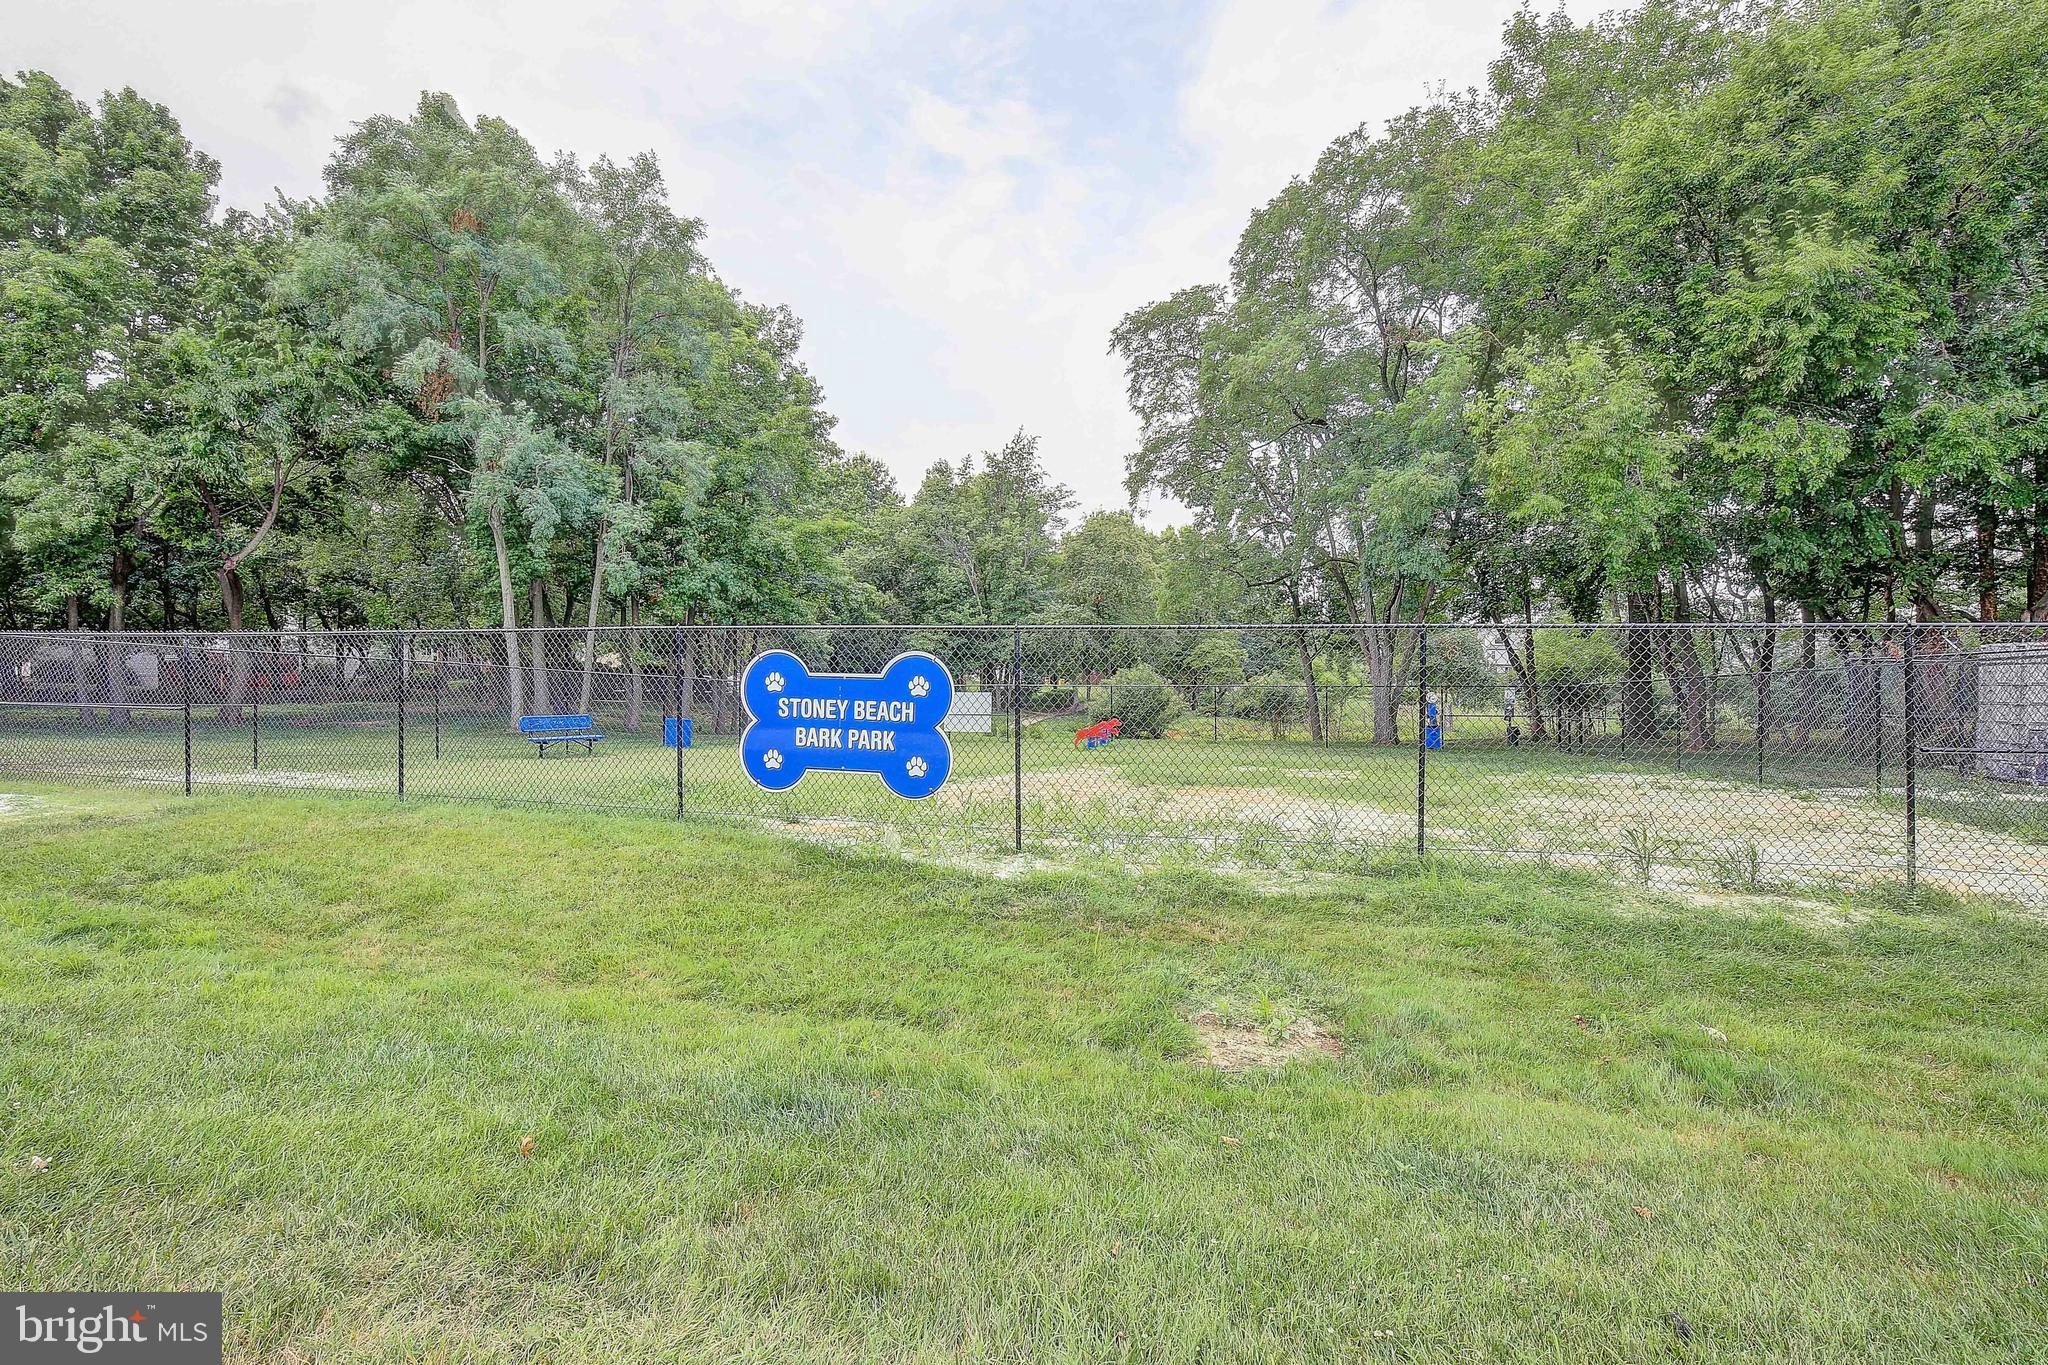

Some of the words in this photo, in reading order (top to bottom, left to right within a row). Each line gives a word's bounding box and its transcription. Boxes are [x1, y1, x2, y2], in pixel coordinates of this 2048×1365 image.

[778, 697, 849, 720] STONEY
[853, 700, 915, 722] BEACH
[795, 727, 842, 749] BARK
[848, 729, 896, 751] PARK
